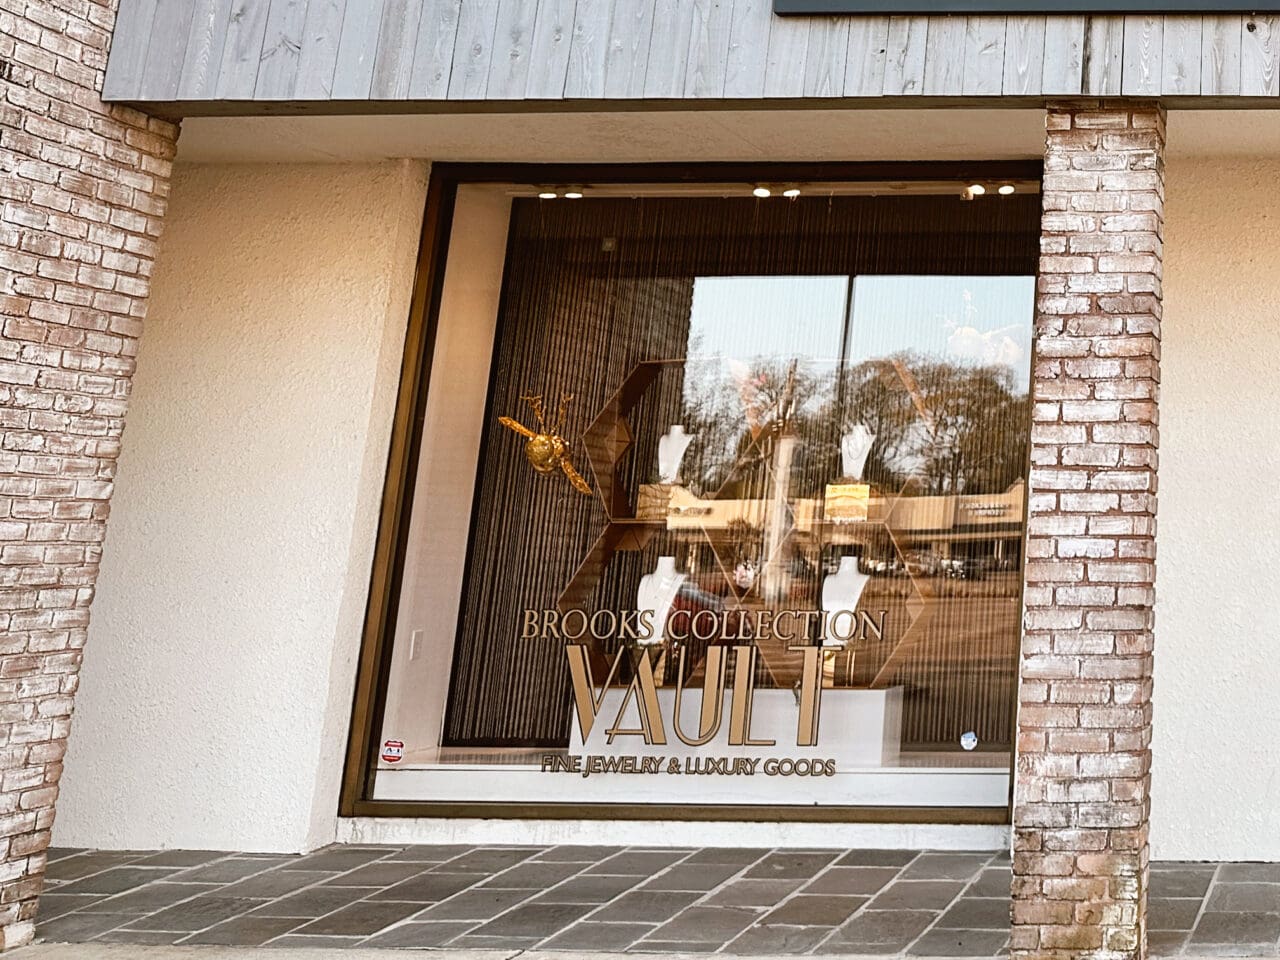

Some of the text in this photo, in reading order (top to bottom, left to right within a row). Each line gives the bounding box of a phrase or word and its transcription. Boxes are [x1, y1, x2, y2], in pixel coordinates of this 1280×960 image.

[520, 608, 887, 641] BROOKS COLLECTION
[565, 644, 843, 747] VAULT
[541, 754, 836, 778] FINE JEWELRY & LUXURY GOODS
